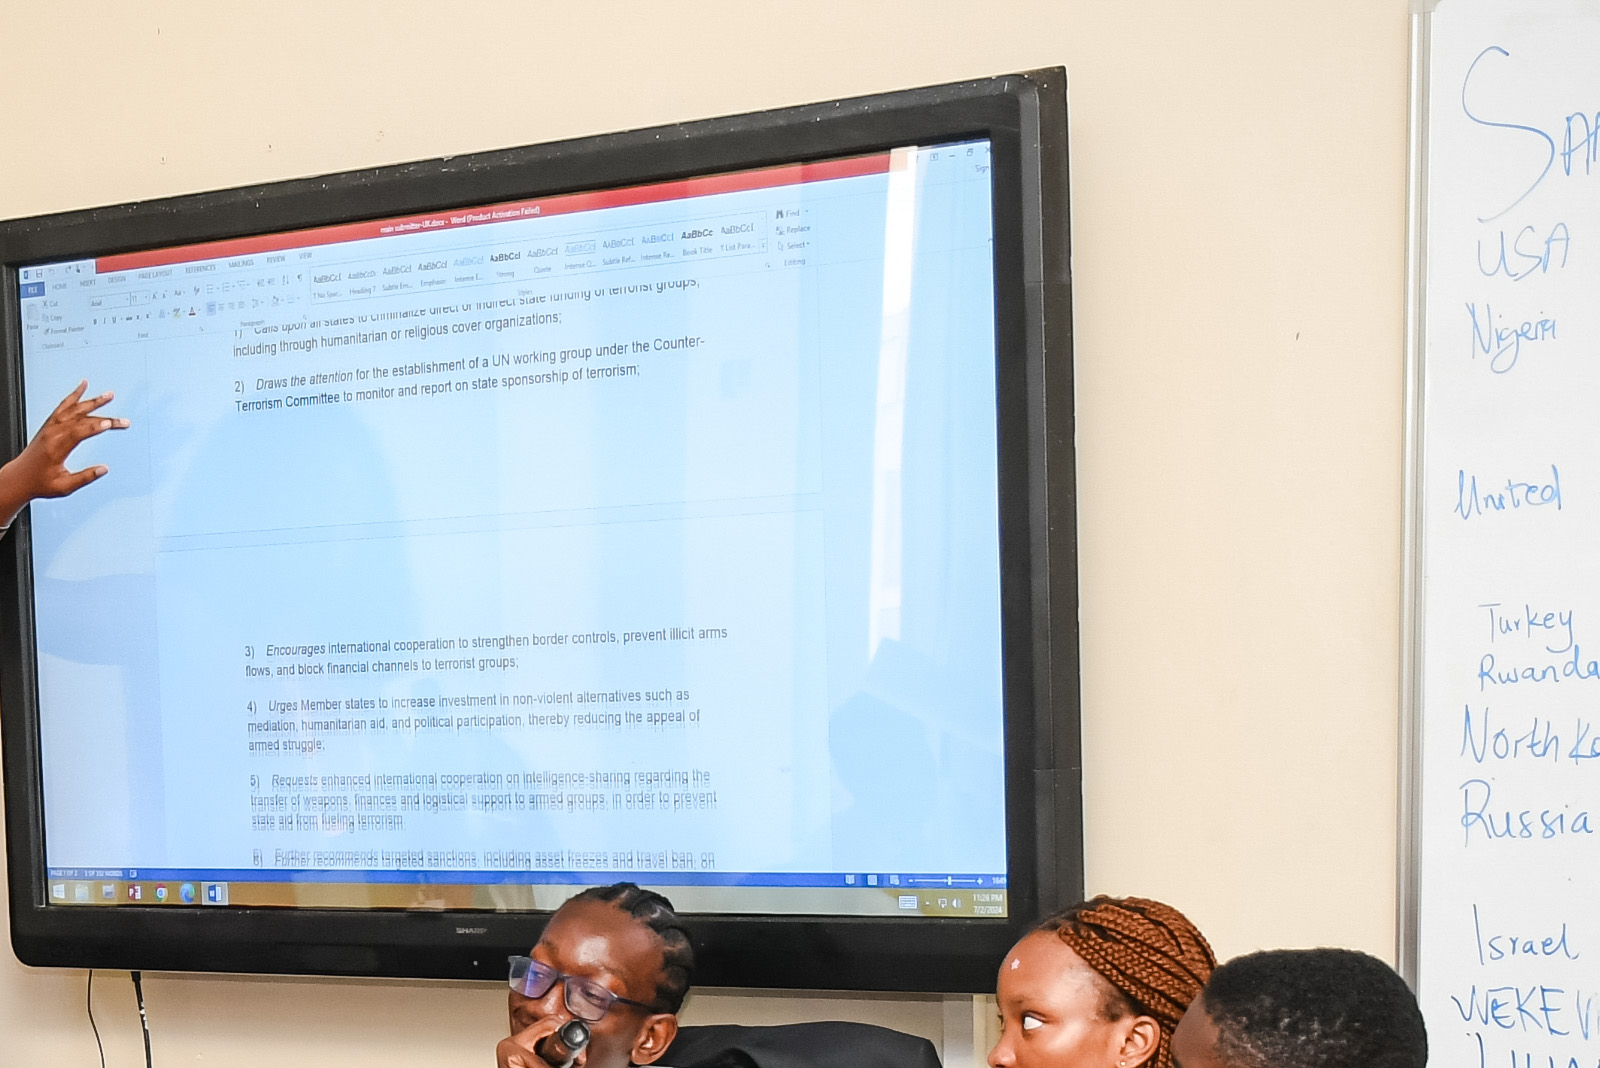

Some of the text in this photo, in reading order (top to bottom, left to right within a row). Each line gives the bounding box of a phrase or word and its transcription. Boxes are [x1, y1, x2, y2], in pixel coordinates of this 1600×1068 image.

[451, 216, 465, 224] Word
[492, 209, 520, 219] Activation
[108, 276, 126, 284] DESIGN
[267, 256, 285, 264] REVIEW
[1477, 222, 1570, 281] USA
[233, 312, 561, 357] including through humanitarian or religious cover organizations;
[235, 336, 705, 394] 2) Draws the attention for the establishment of a UN working group under the Counter-
[235, 364, 640, 412] Terrorism Committee to monitor and report on state sponsorship of terrorism;
[1453, 464, 1562, 521] United
[245, 627, 727, 658] 3) Encourages international cooperation to strengthen border controls, prevent illicit arms
[1478, 603, 1573, 653] Turkey
[246, 656, 518, 678] flows, and block financial channels to terrorist groups;
[1478, 644, 1600, 691] Rwanda
[247, 688, 689, 714] 4) Urges Member states to increase investment in non-violent alternatives such as
[248, 709, 700, 732] mediation, humanitarian aid, and political participation, thereby reducing the appeal of
[249, 739, 325, 752] armed struggle;
[1460, 704, 1559, 763] North
[1459, 777, 1594, 848] Russia
[1473, 903, 1580, 967] Israel
[1451, 985, 1569, 1035] WEKE
